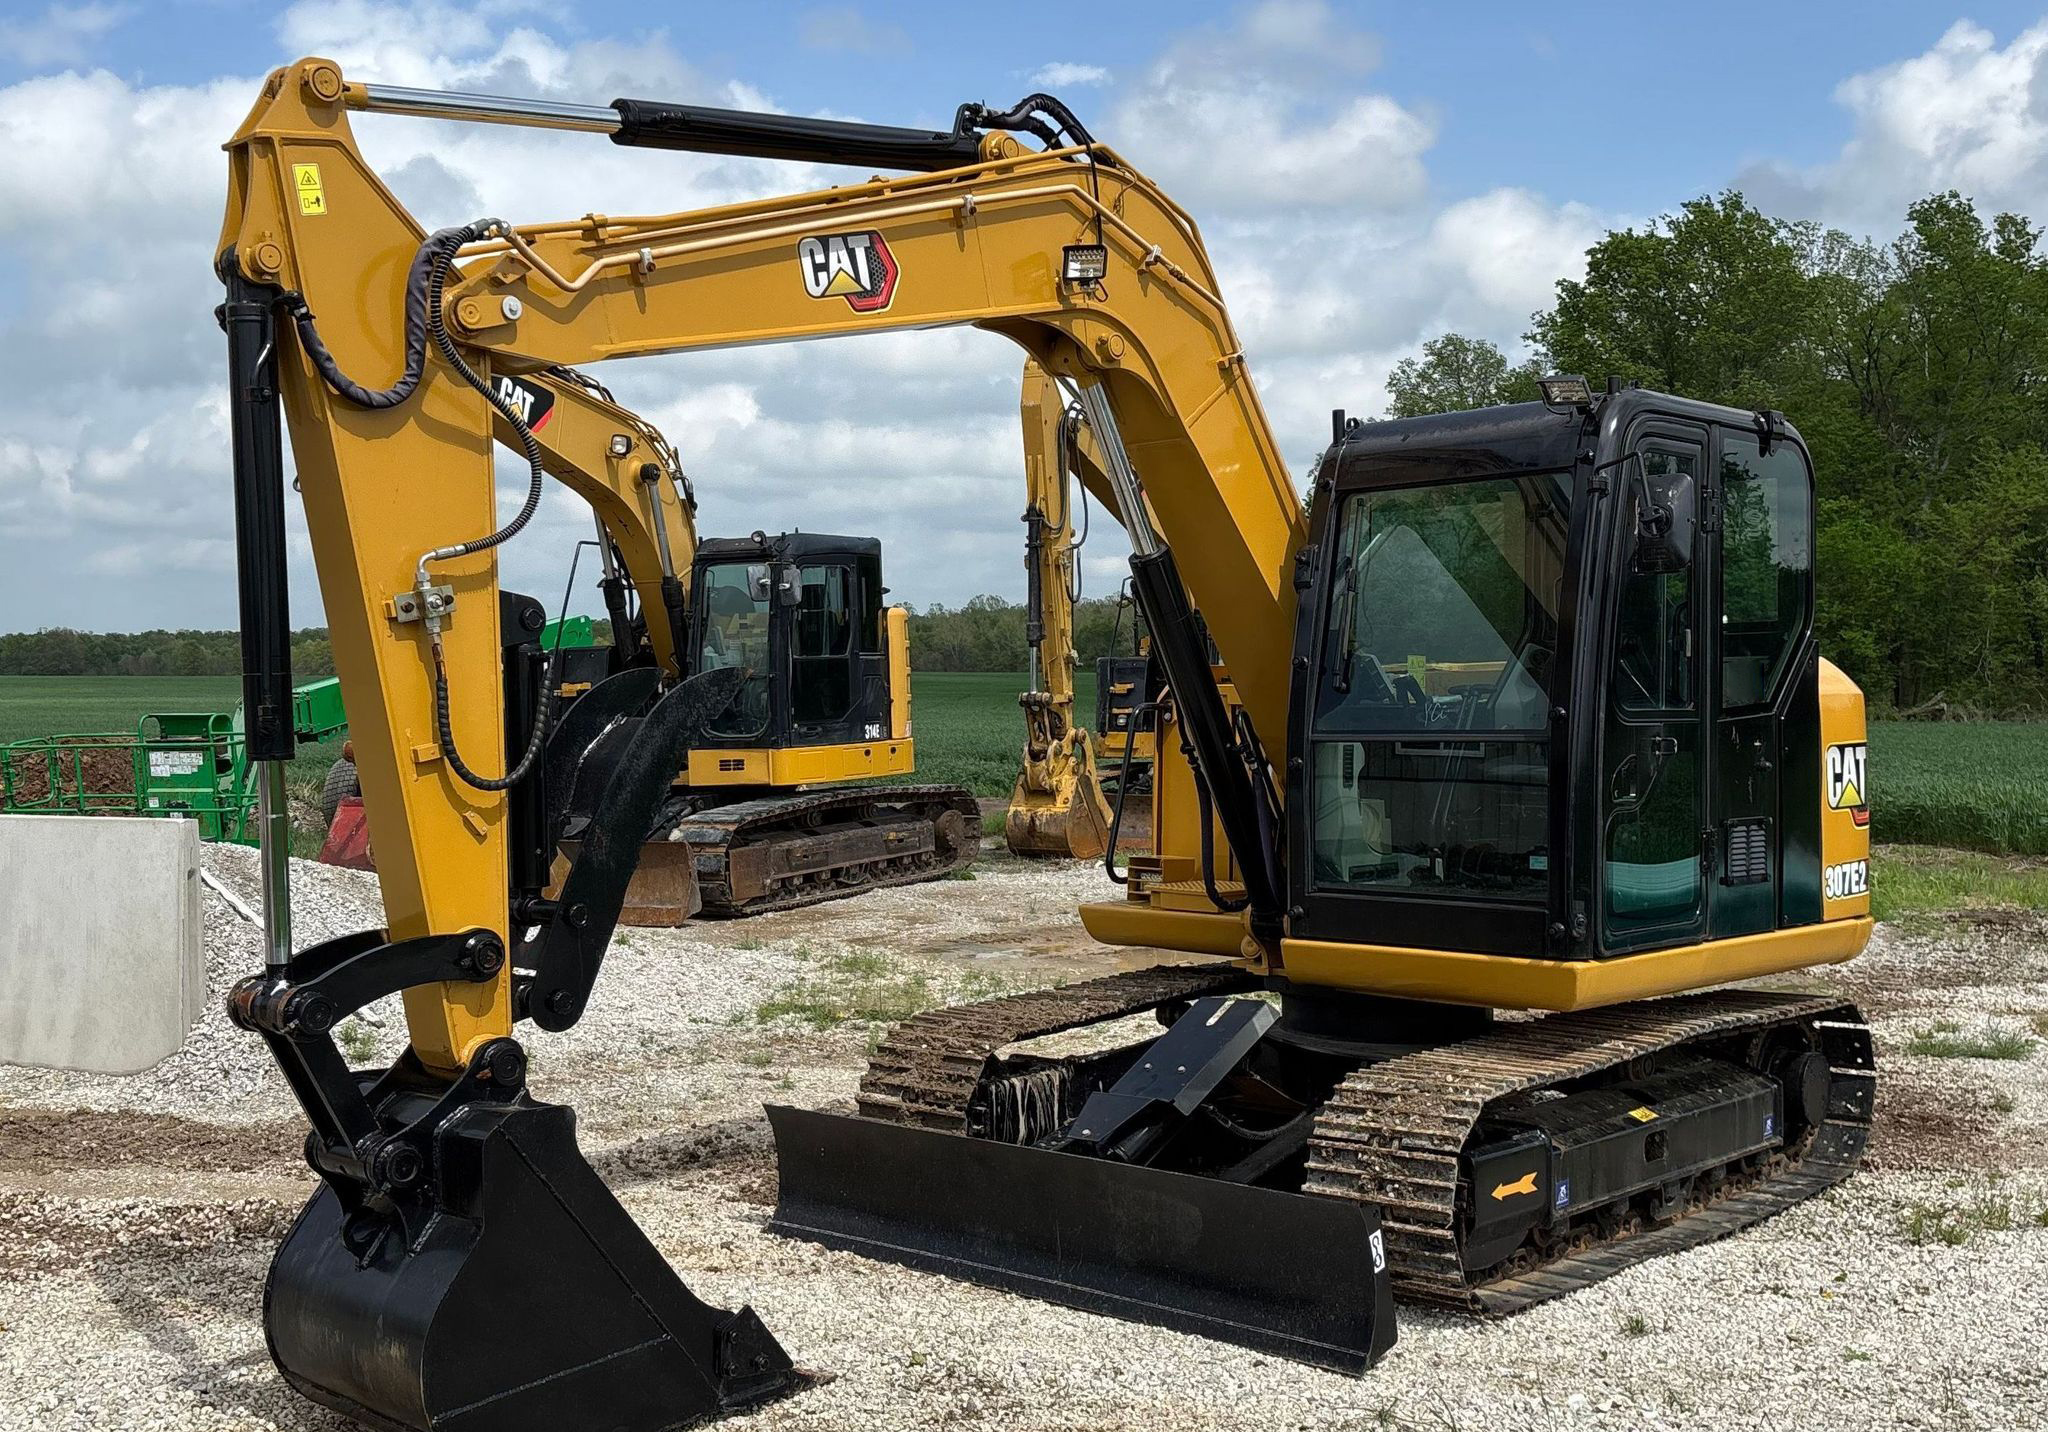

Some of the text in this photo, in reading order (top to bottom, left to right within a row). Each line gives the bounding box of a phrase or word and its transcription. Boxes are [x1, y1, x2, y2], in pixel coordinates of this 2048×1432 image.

[799, 234, 872, 297] CAT
[500, 377, 535, 423] CAT
[864, 723, 880, 740] 314E
[1826, 746, 1867, 808] CAT
[1825, 860, 1867, 899] 307E2
